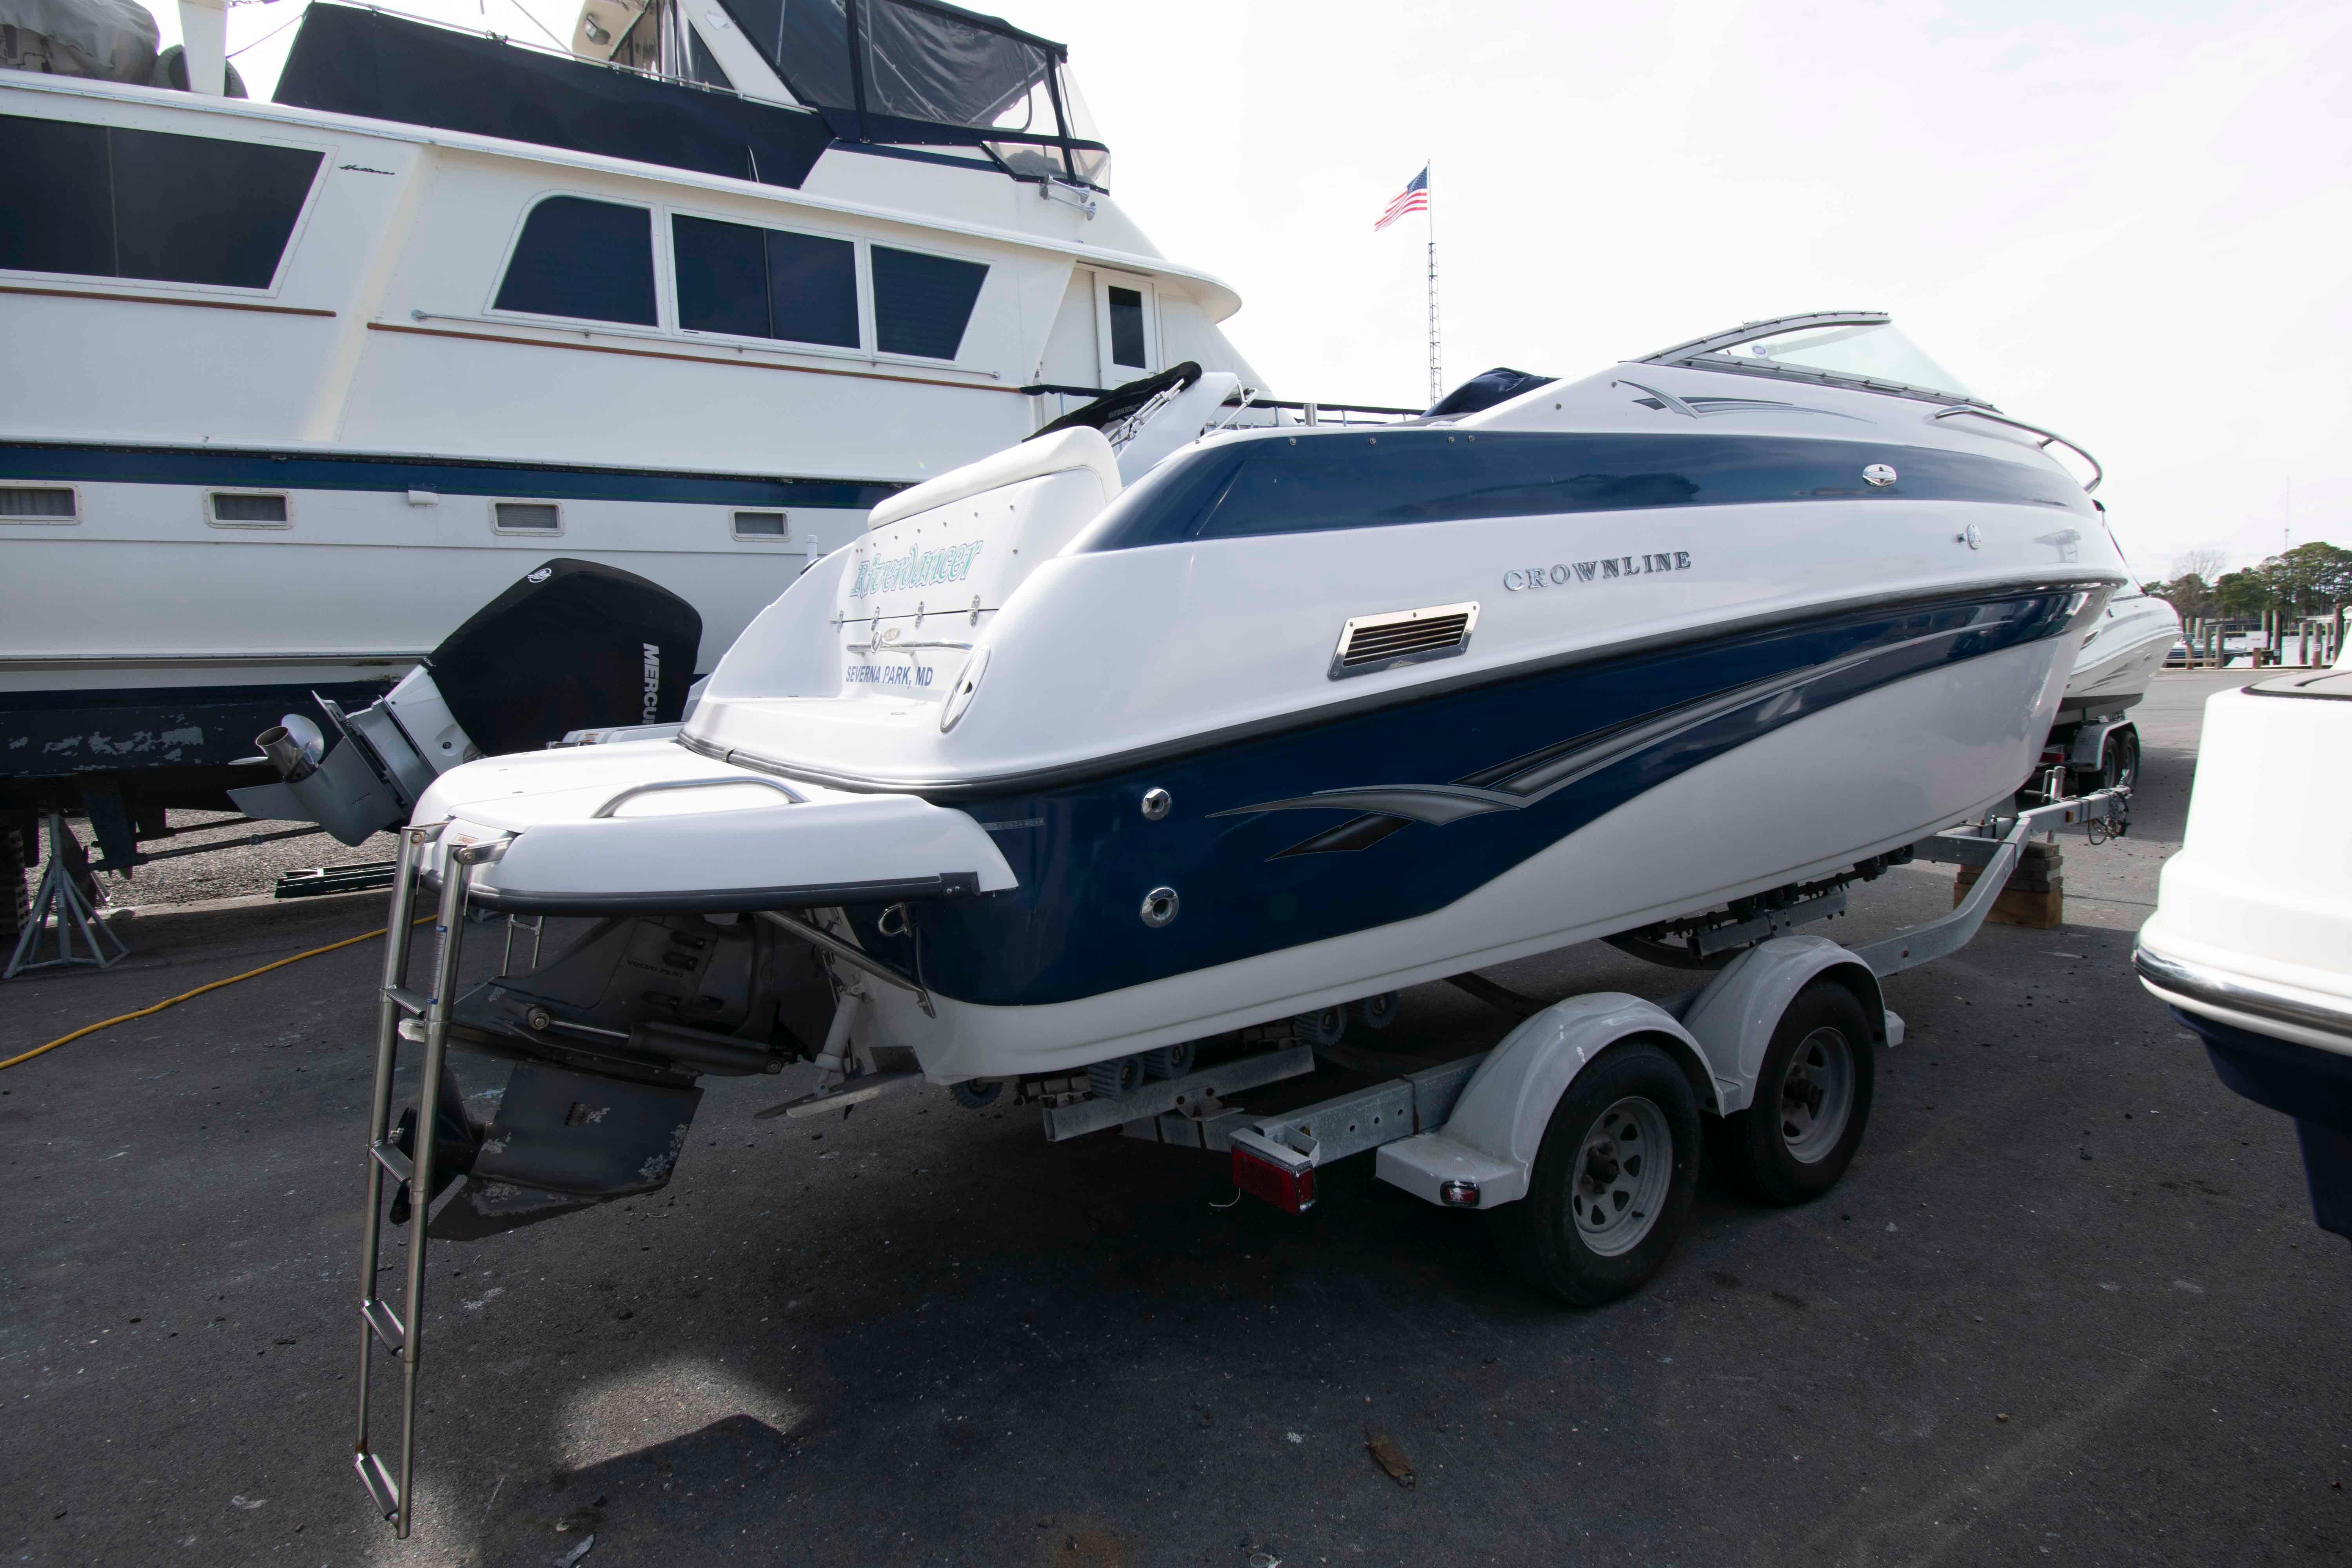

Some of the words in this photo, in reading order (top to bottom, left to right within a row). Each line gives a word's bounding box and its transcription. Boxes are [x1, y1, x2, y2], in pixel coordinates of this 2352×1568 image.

[850, 540, 984, 599] Riverdancer
[1504, 551, 1691, 591] CROWNLINE
[846, 665, 881, 683] SEVERNA
[882, 666, 911, 690] PARK,
[915, 666, 933, 686] MD
[627, 960, 657, 972] VOLVO
